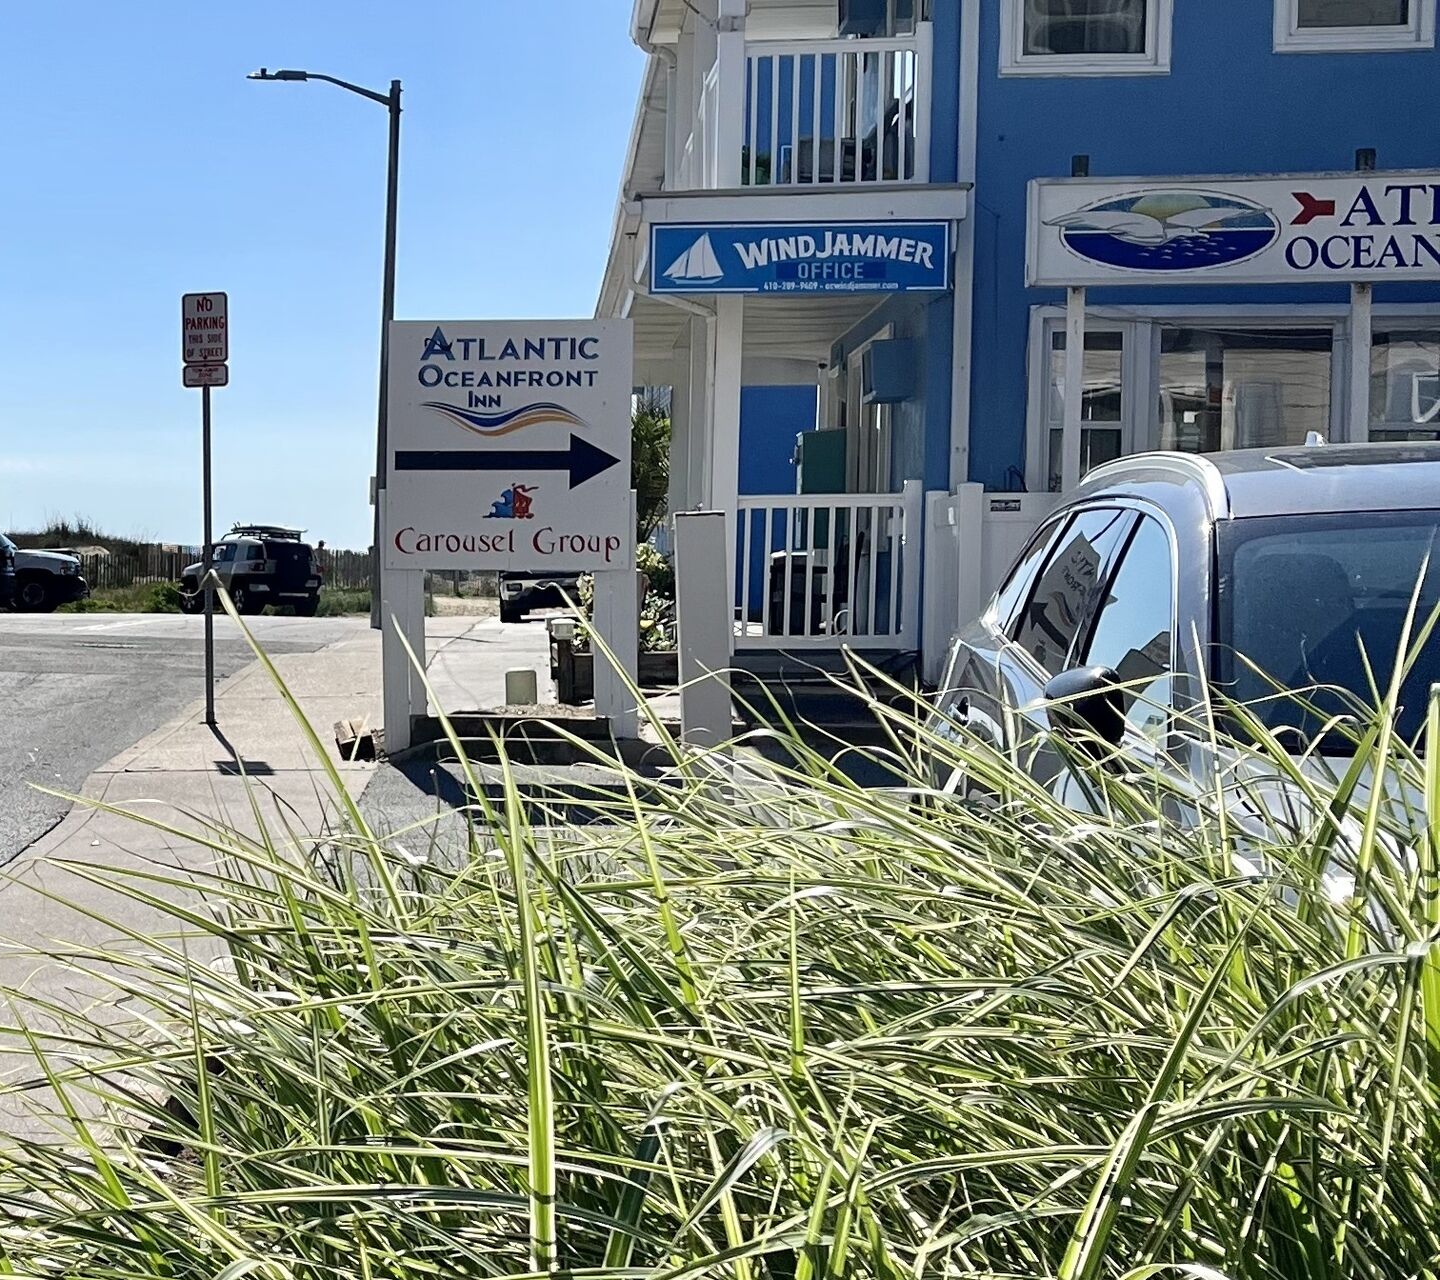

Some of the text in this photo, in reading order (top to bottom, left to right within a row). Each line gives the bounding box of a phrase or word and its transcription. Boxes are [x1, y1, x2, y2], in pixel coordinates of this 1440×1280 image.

[732, 231, 934, 270] WINDJAMMER
[797, 261, 865, 279] OFFICE
[196, 298, 213, 312] NO
[185, 316, 225, 330] PARKING
[420, 325, 600, 361] ATLANTIC
[186, 347, 223, 358] OF STREET
[418, 363, 599, 388] OCEANFRONT
[468, 391, 501, 408] INN
[395, 527, 621, 562] Carousel Group
